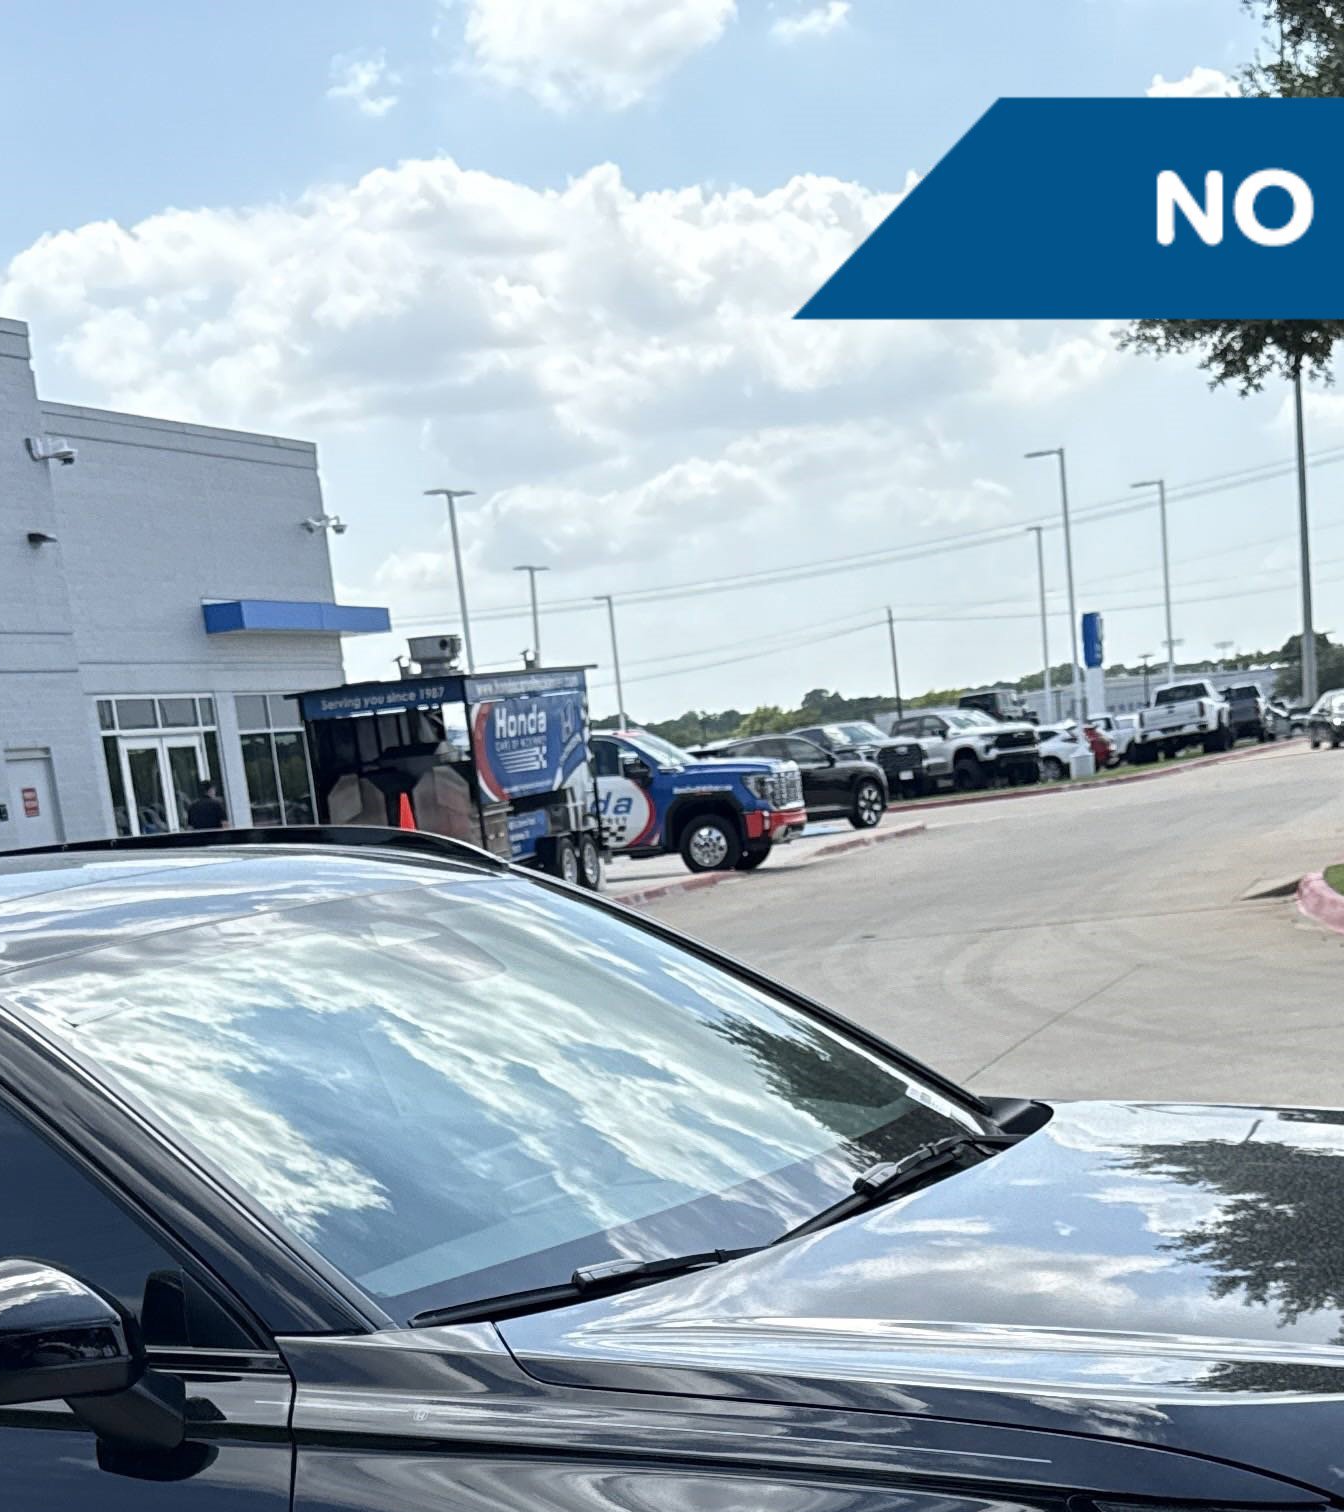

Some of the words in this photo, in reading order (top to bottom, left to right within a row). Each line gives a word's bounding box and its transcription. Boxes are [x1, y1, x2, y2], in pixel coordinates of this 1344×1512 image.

[320, 697, 361, 711] Serving
[363, 696, 385, 708] you
[386, 691, 416, 703] since
[419, 686, 444, 700] 1987
[495, 703, 547, 739] Honda
